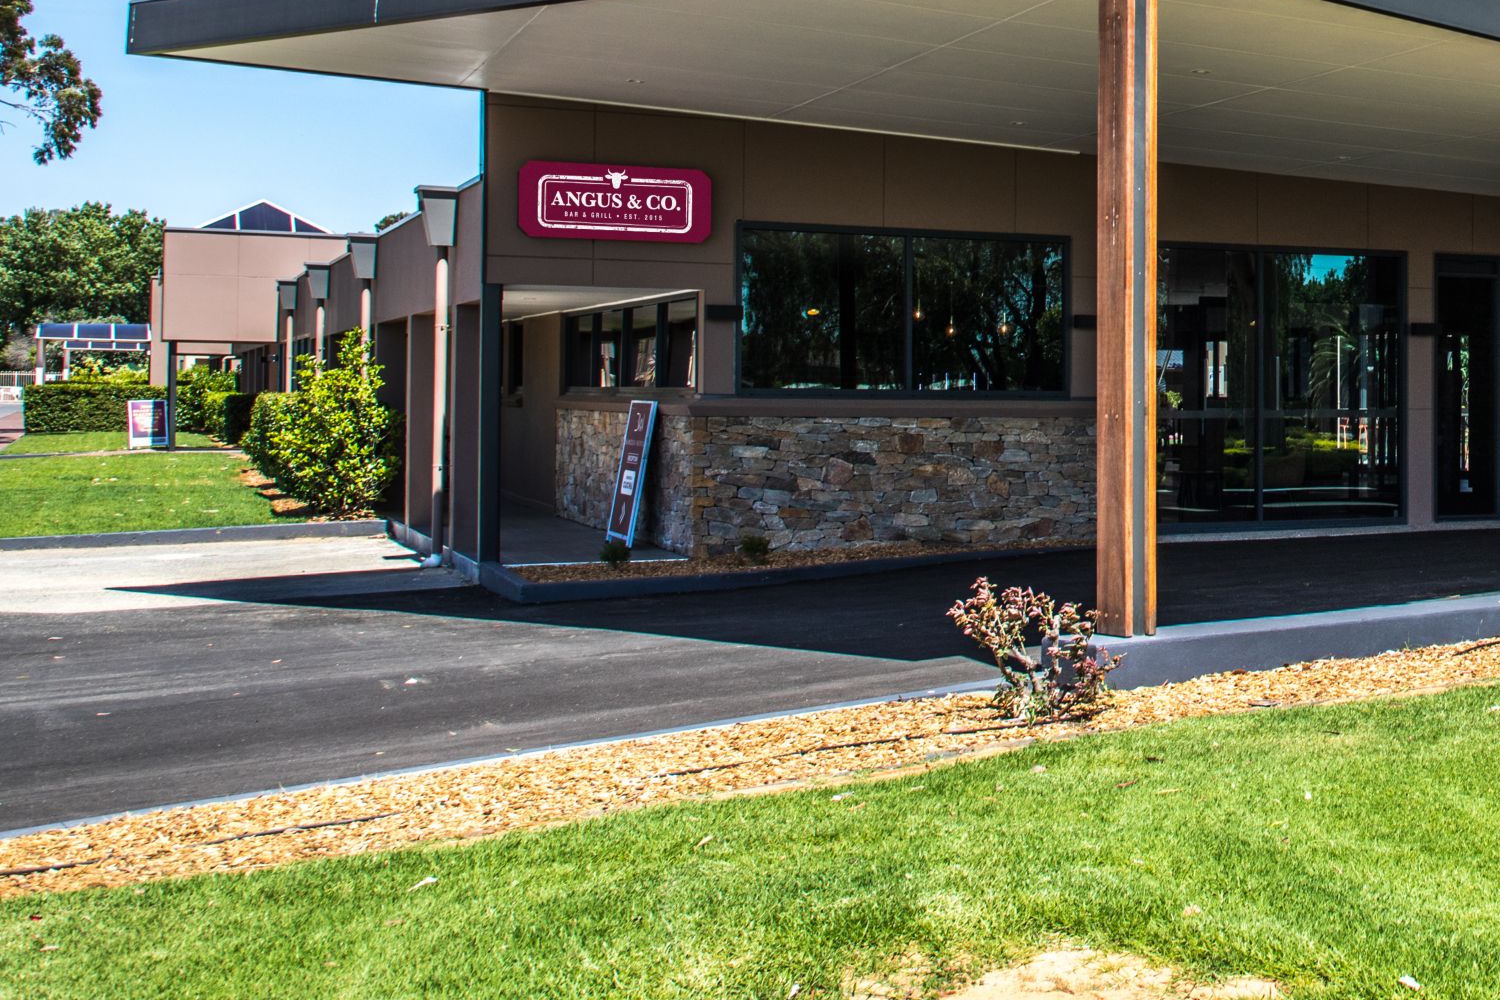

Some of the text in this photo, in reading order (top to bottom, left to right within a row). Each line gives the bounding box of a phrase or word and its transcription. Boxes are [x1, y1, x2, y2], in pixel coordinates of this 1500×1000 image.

[551, 191, 681, 211] ANGUS & CO.
